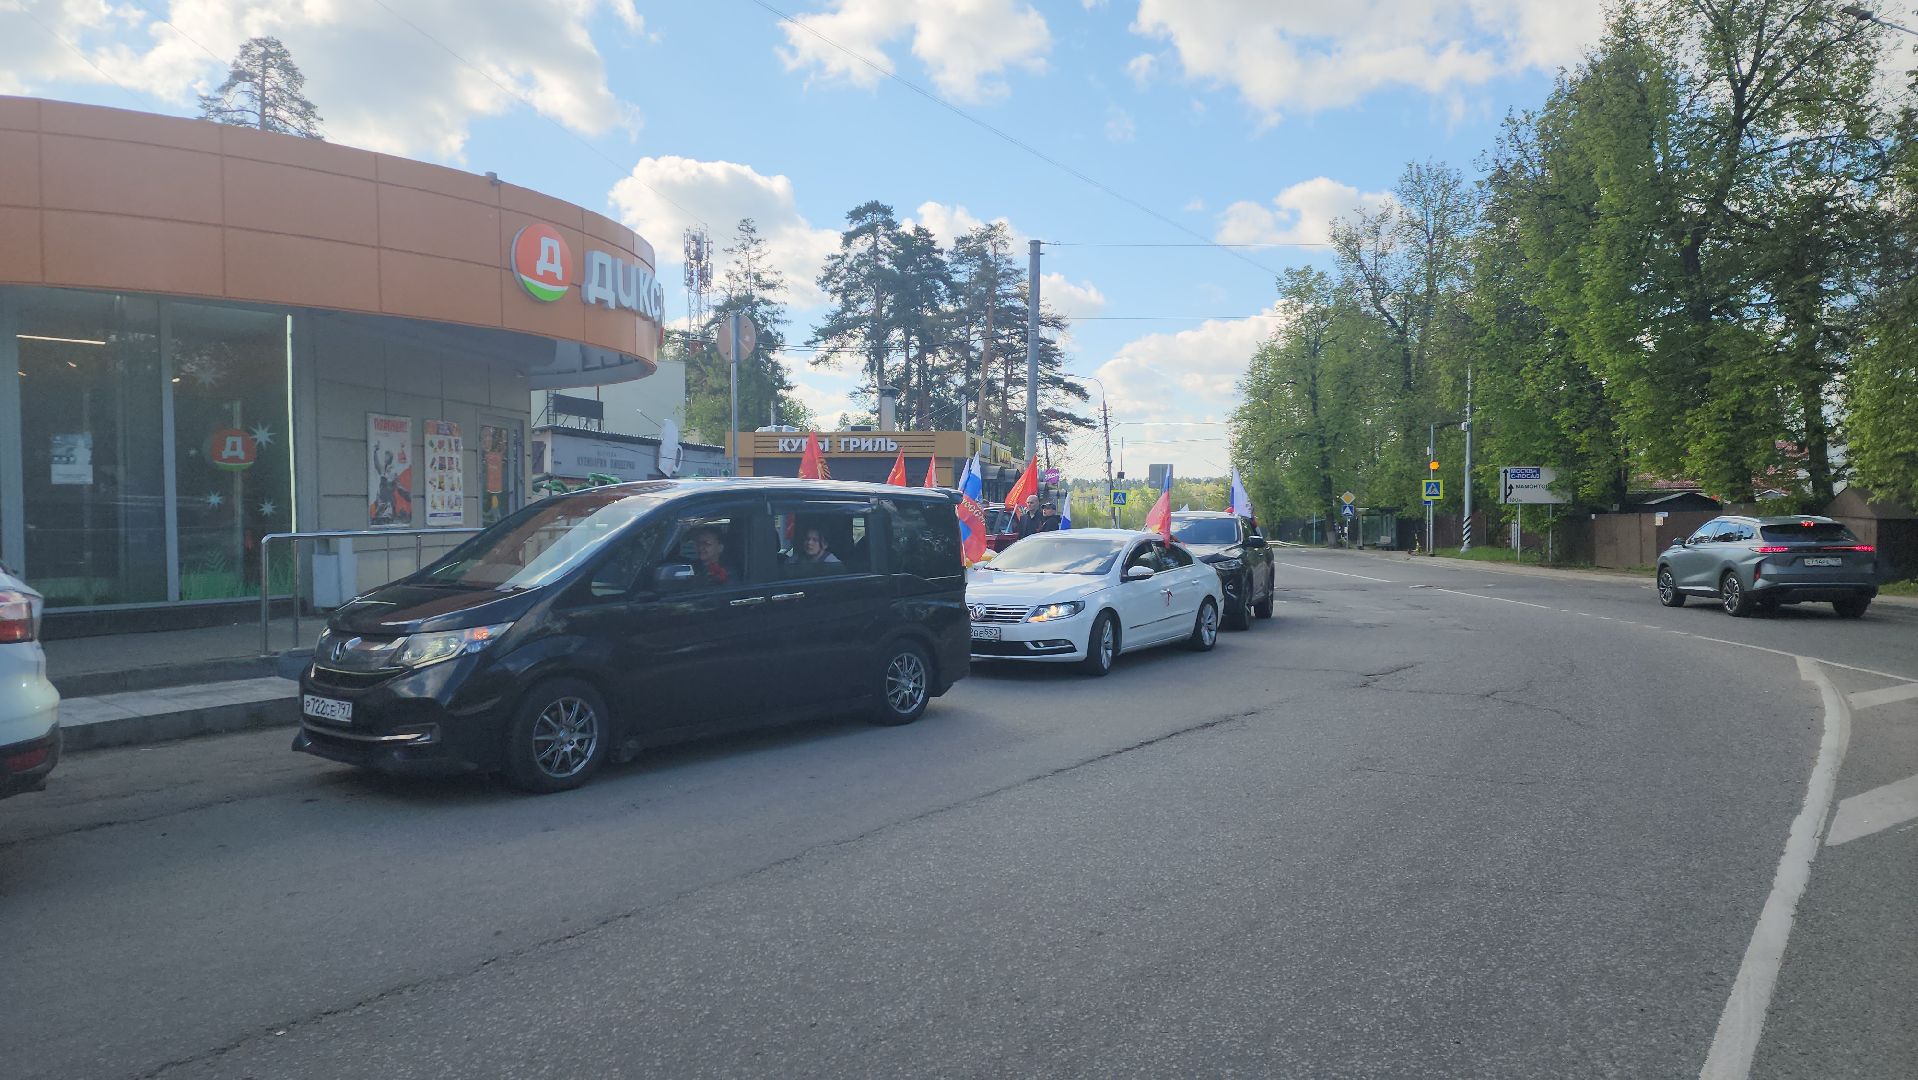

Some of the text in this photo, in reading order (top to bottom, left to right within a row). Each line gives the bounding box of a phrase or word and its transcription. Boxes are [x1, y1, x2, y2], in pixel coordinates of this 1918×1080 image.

[536, 236, 563, 280] Д
[583, 250, 664, 326] ДИКС
[222, 436, 245, 460] Д
[840, 437, 898, 452] ГРИЛЬ
